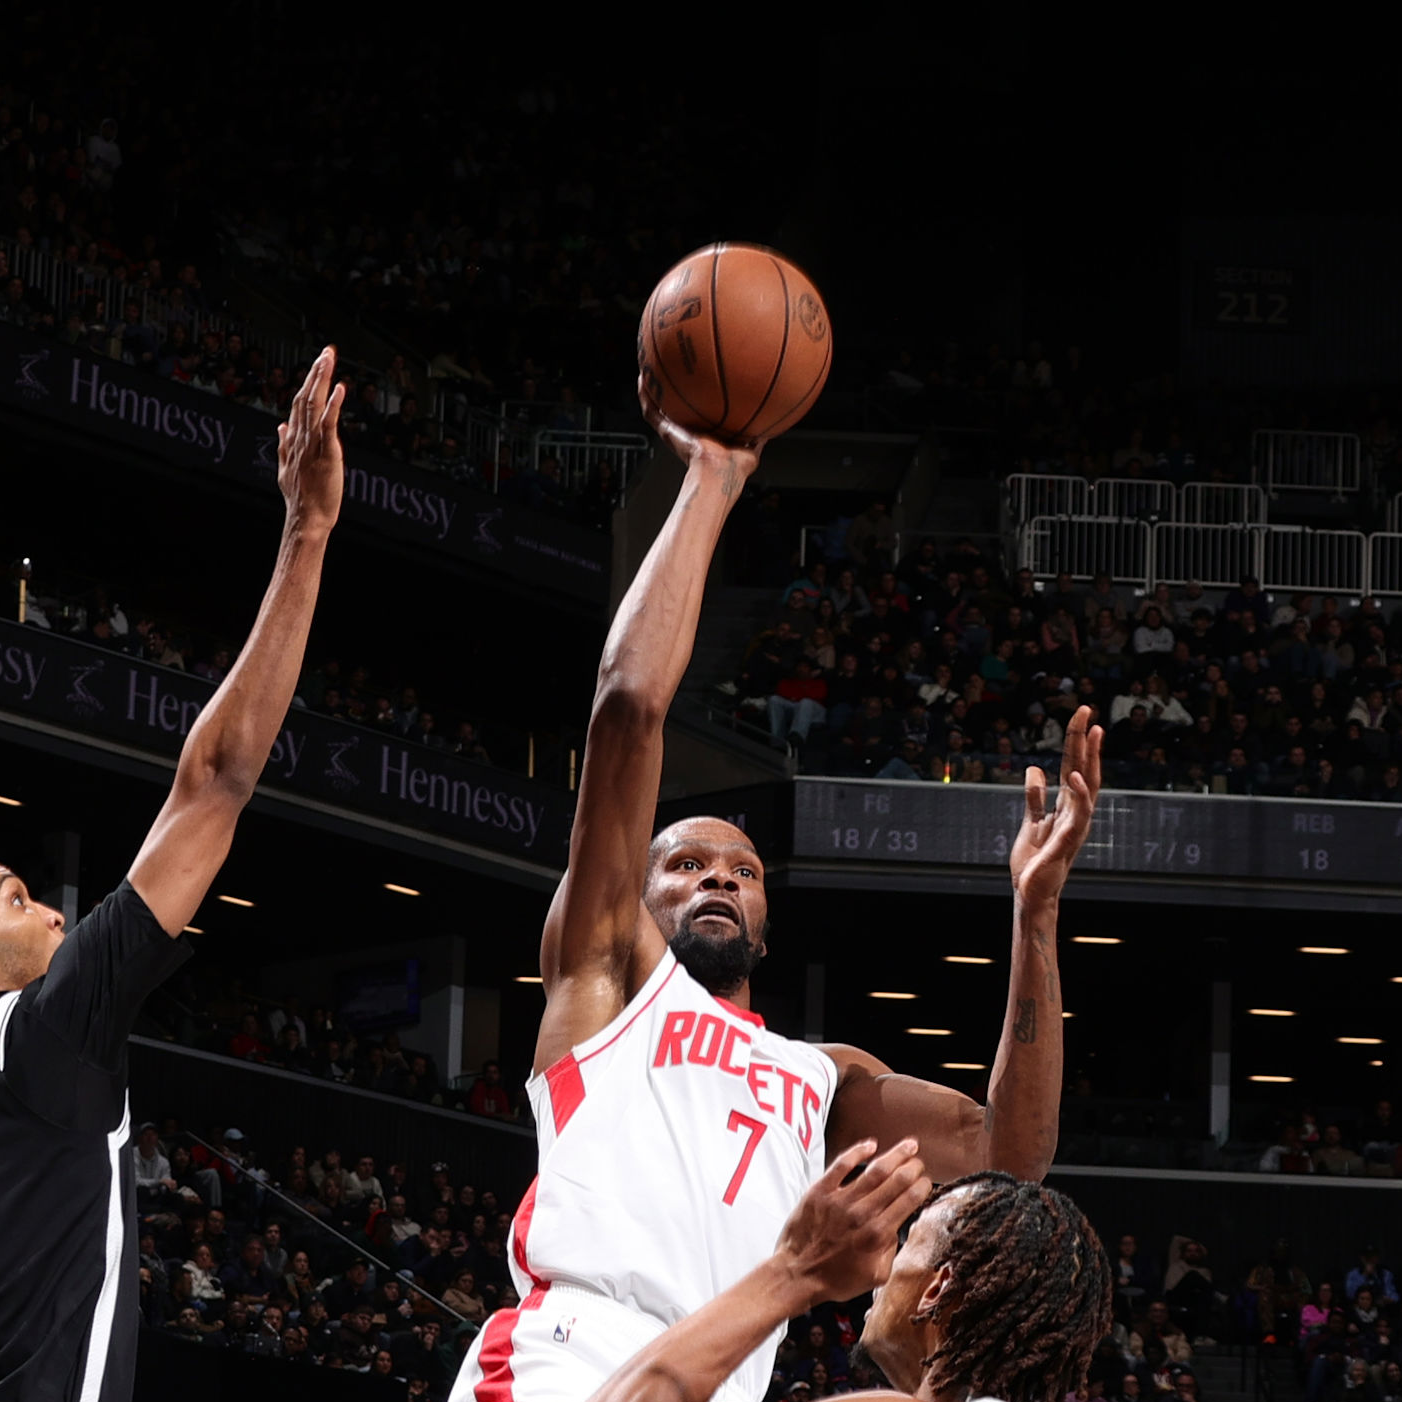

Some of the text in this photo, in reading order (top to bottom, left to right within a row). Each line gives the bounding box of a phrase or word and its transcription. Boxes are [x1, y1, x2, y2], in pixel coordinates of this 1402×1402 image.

[1216, 290, 1290, 325] 212
[69, 358, 235, 463] Hennessy
[379, 744, 545, 848] Hennessy
[863, 792, 890, 814] FG
[1293, 813, 1335, 834] REB
[831, 828, 861, 849] 18
[887, 831, 918, 852] 33
[1143, 841, 1159, 862] 7
[1184, 843, 1200, 865] 9
[1299, 849, 1330, 872] 18
[722, 1109, 767, 1207] 7
